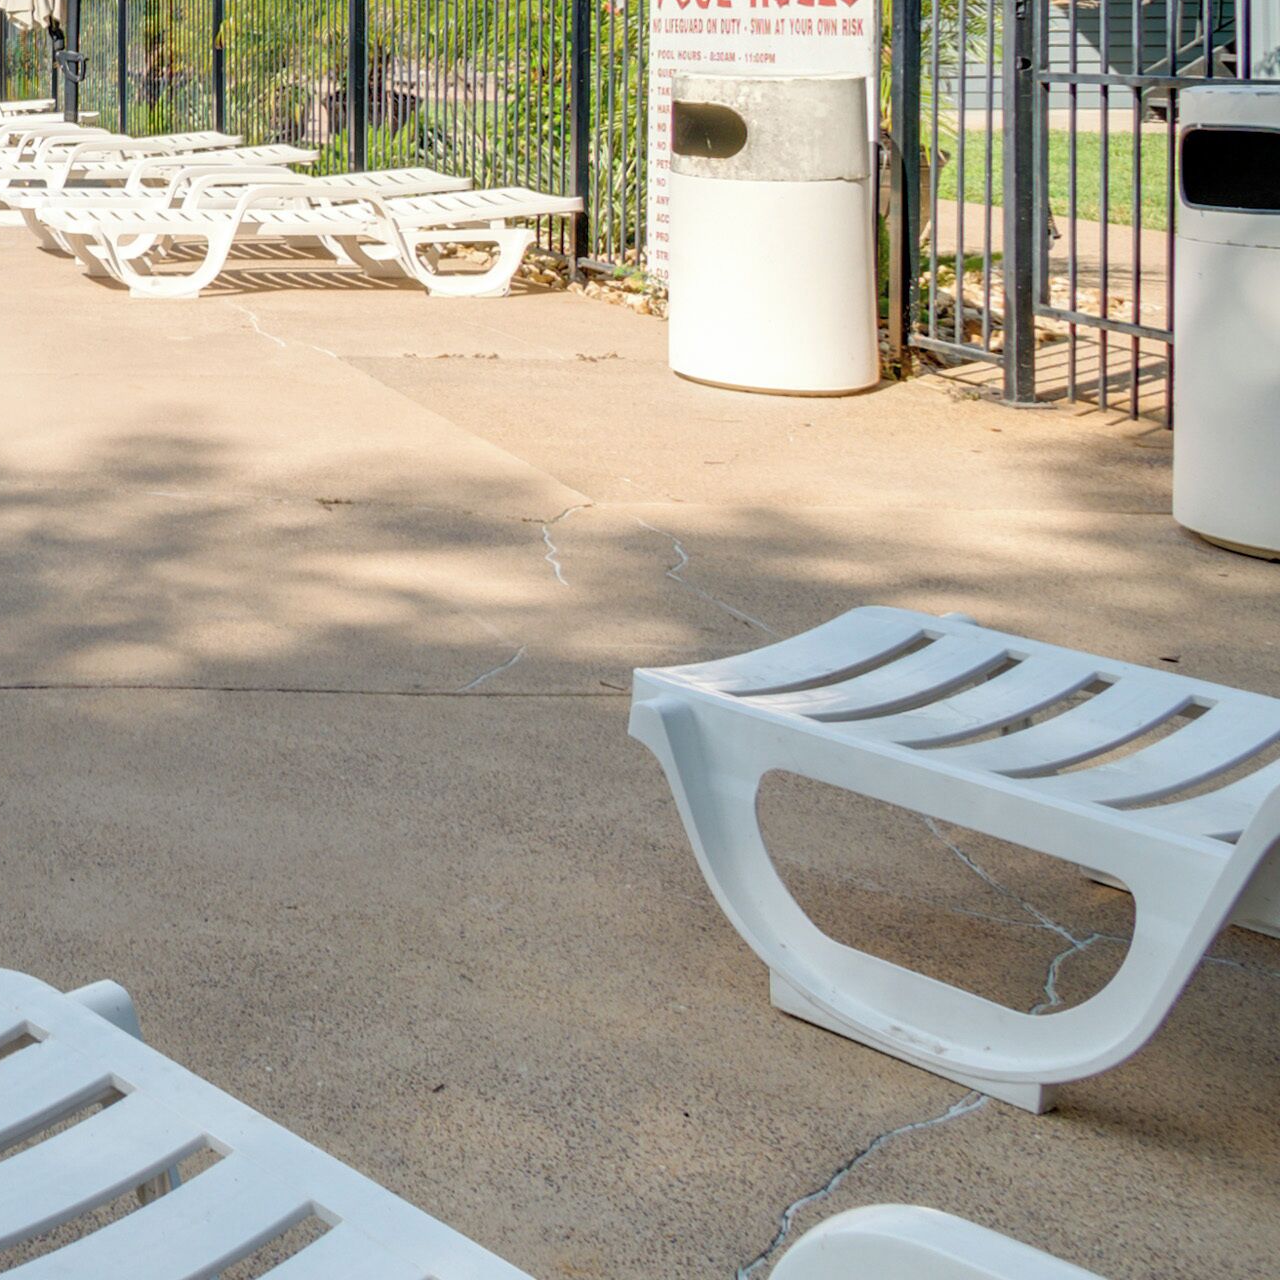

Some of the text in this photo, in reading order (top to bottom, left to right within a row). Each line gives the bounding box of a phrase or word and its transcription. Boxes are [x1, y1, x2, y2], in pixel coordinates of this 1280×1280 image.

[653, 19, 662, 33] NO
[664, 19, 704, 34] LIFEGUARD
[707, 19, 717, 34] ON
[720, 19, 742, 35] DUTY
[750, 19, 771, 35] SWIM
[775, 19, 786, 35] AT
[790, 18, 812, 36] YOUR
[817, 18, 837, 36] OWN
[842, 18, 864, 36] RISK
[657, 51, 675, 59] POOL
[678, 51, 702, 60] HOURS
[710, 52, 736, 62] 8:30AM
[744, 53, 776, 64] 11:00PM
